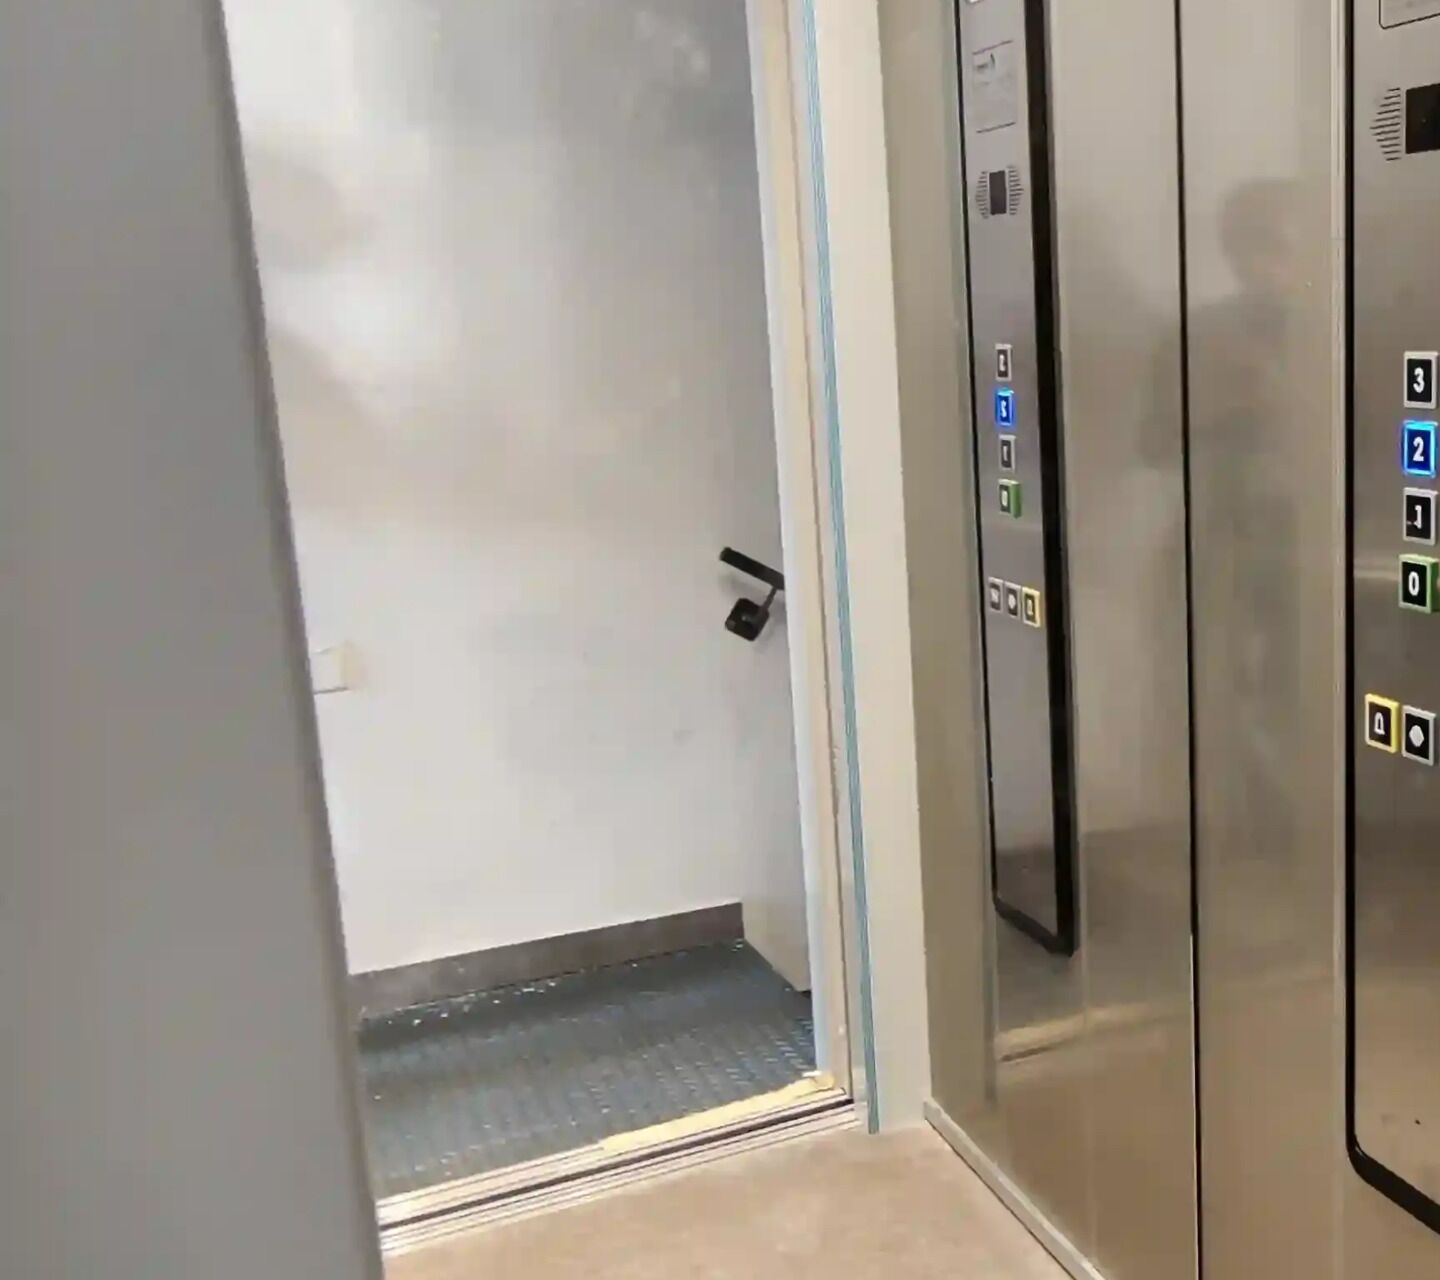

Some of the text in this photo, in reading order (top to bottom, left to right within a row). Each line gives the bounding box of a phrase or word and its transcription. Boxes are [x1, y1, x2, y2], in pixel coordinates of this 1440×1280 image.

[1412, 367, 1425, 394] 3
[1412, 436, 1425, 462] 2
[1413, 504, 1423, 529] 1
[1408, 571, 1420, 597] 0
